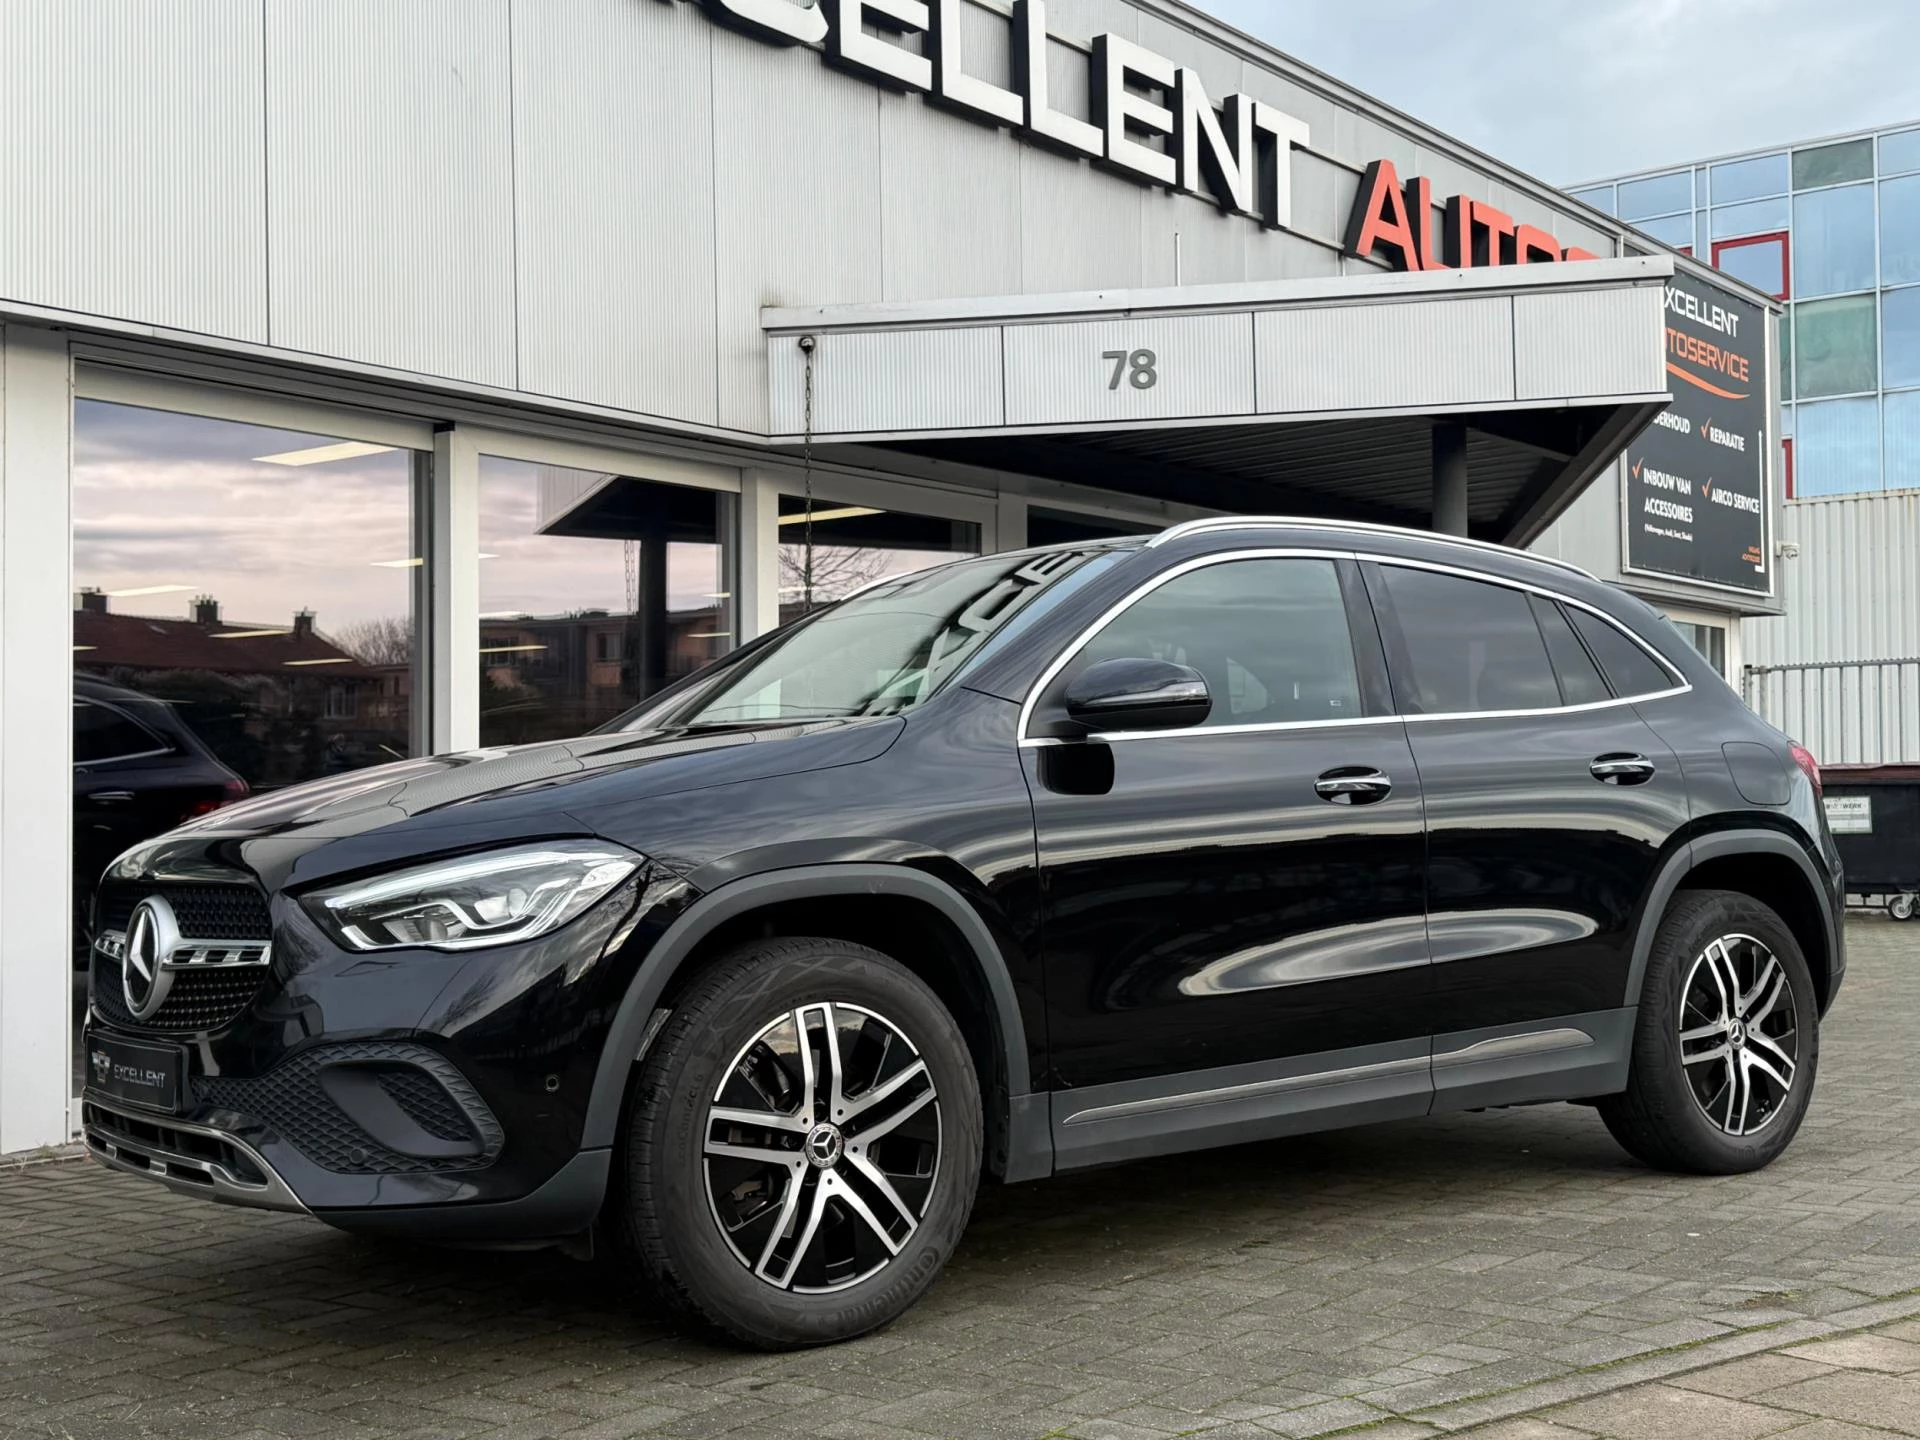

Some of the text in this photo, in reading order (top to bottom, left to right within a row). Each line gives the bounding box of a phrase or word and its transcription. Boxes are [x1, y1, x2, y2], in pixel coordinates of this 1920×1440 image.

[720, 0, 1309, 228] ELLENT
[1102, 348, 1157, 390] 78
[1709, 426, 1745, 452] REPARATIE
[1643, 467, 1692, 495] INBOUW VAN
[1644, 496, 1693, 523] ACCESSOIRES
[1711, 488, 1760, 514] AIRCO SERVICE
[114, 1064, 166, 1088] EXCELLENT
